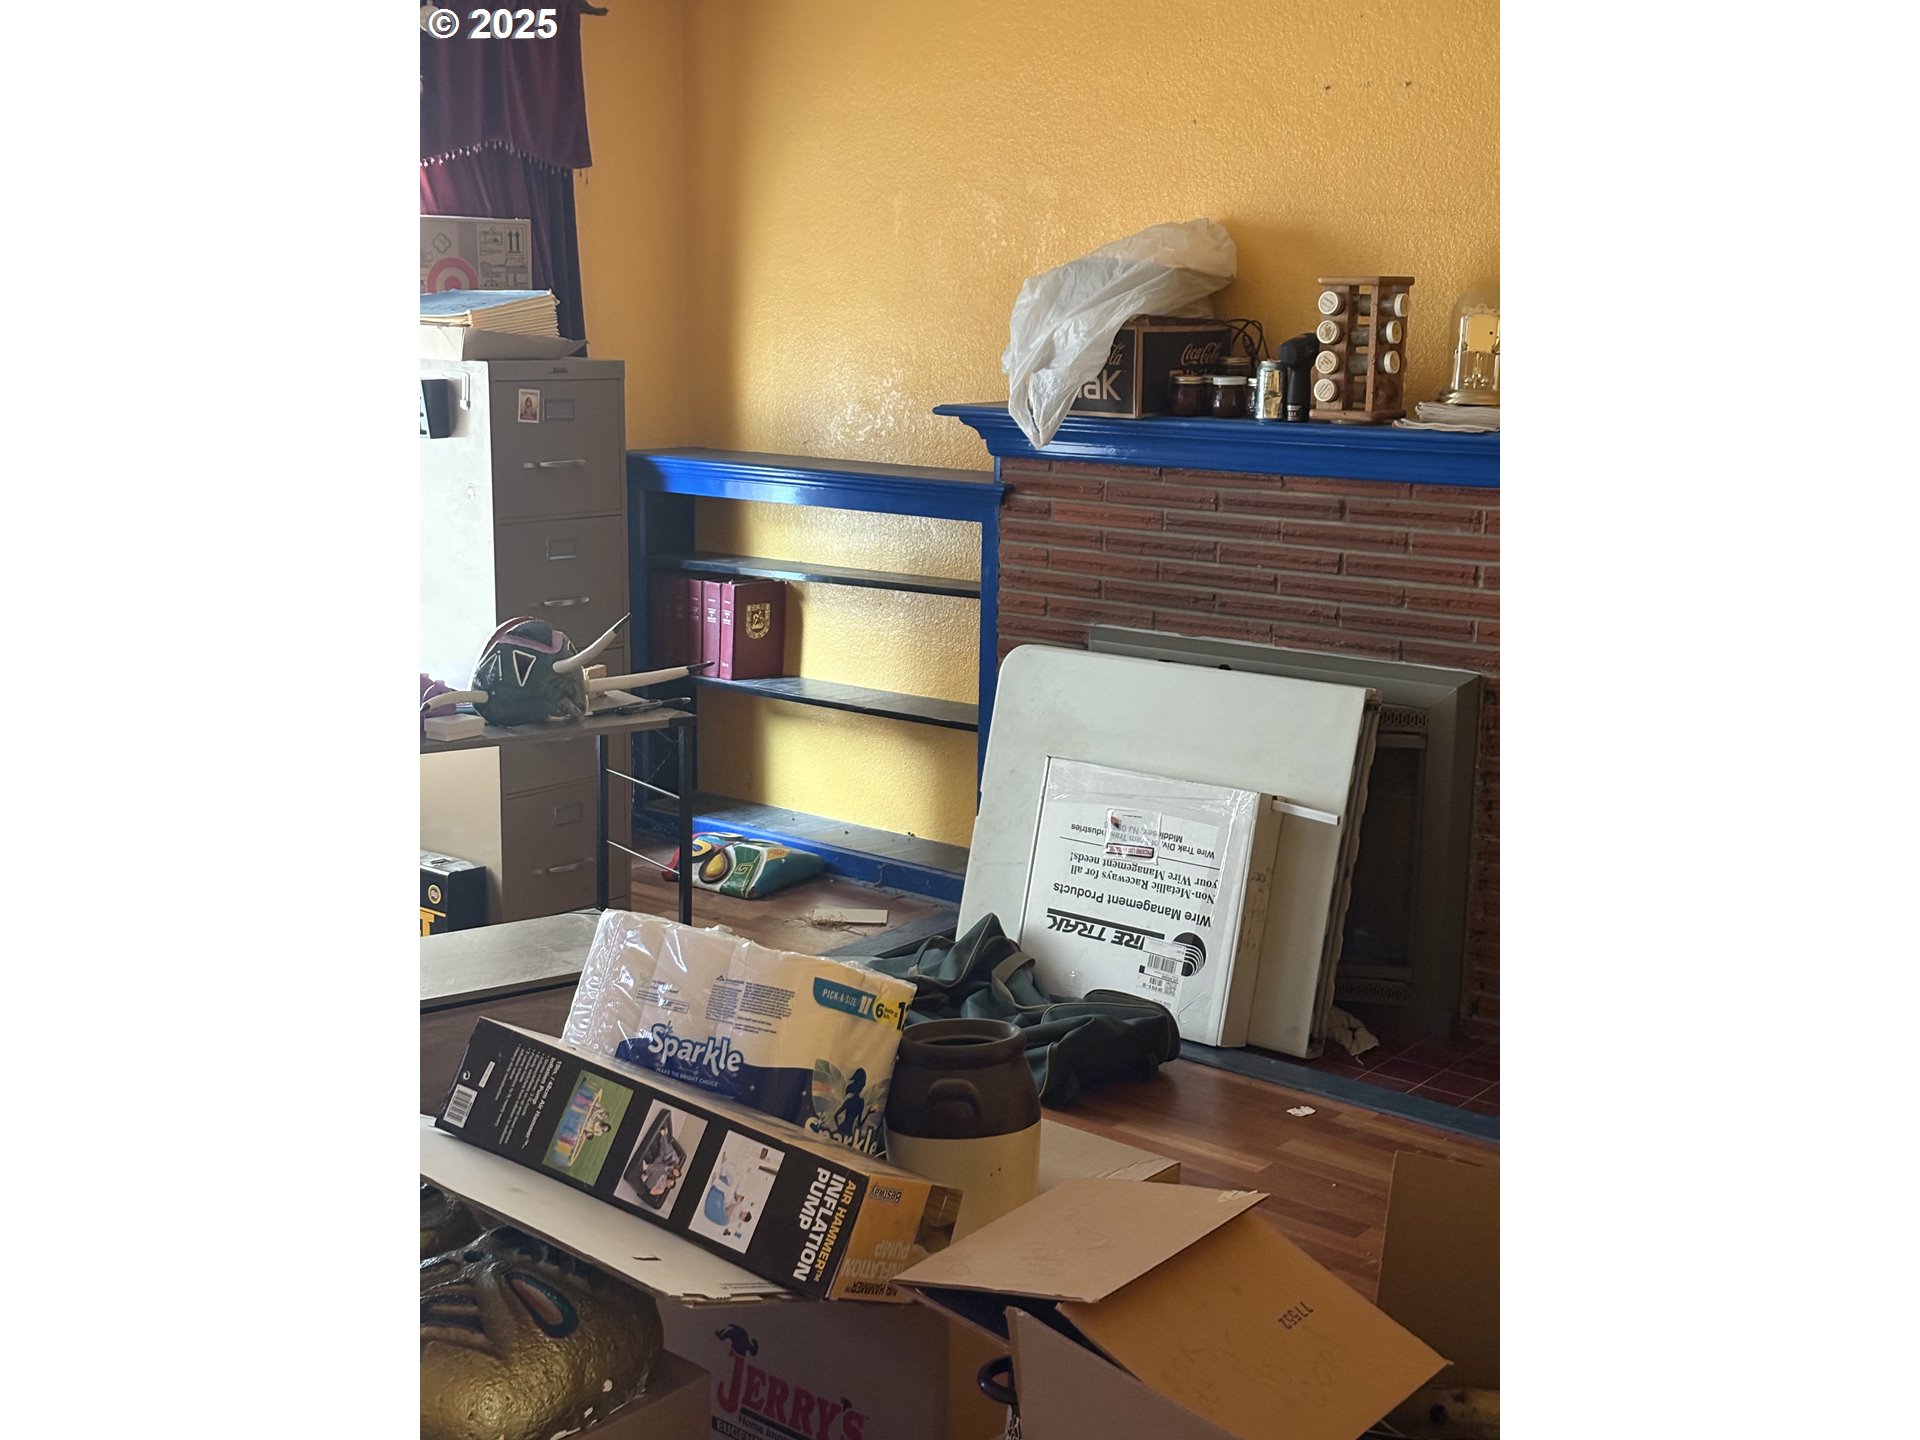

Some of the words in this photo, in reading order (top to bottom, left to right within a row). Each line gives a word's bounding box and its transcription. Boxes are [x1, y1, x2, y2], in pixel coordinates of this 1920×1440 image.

[1070, 823, 1106, 836] ndustries
[1161, 841, 1176, 851] Div.
[1178, 843, 1195, 855] Trak
[1197, 848, 1216, 860] Wire
[1070, 851, 1100, 865] needs!
[1070, 864, 1084, 875] all
[1084, 867, 1100, 880] for
[1101, 869, 1149, 890] Raceways
[1102, 857, 1166, 881] Management
[1167, 871, 1192, 887] Wire
[1053, 882, 1105, 903] Products
[1151, 881, 1216, 905] Non-Metallic
[1194, 878, 1219, 889] your
[1107, 894, 1182, 921] Management
[1046, 914, 1107, 942] TRAK
[1184, 911, 1212, 928] Wire
[1110, 929, 1146, 951] IRE
[822, 988, 857, 1007] PICK-A-SIZE
[875, 1002, 885, 1019] 6
[896, 1001, 910, 1031] 1
[648, 1023, 743, 1077] Sparkle
[699, 1078, 719, 1088] CHOICE
[799, 1167, 832, 1231] PUMP
[841, 1179, 857, 1205] AIR
[792, 1173, 847, 1283] INFLATION
[874, 1240, 912, 1260] PUMP
[1278, 1301, 1314, 1330] 77552
[717, 1419, 758, 1440] EUGE
[738, 1414, 765, 1435] Home
